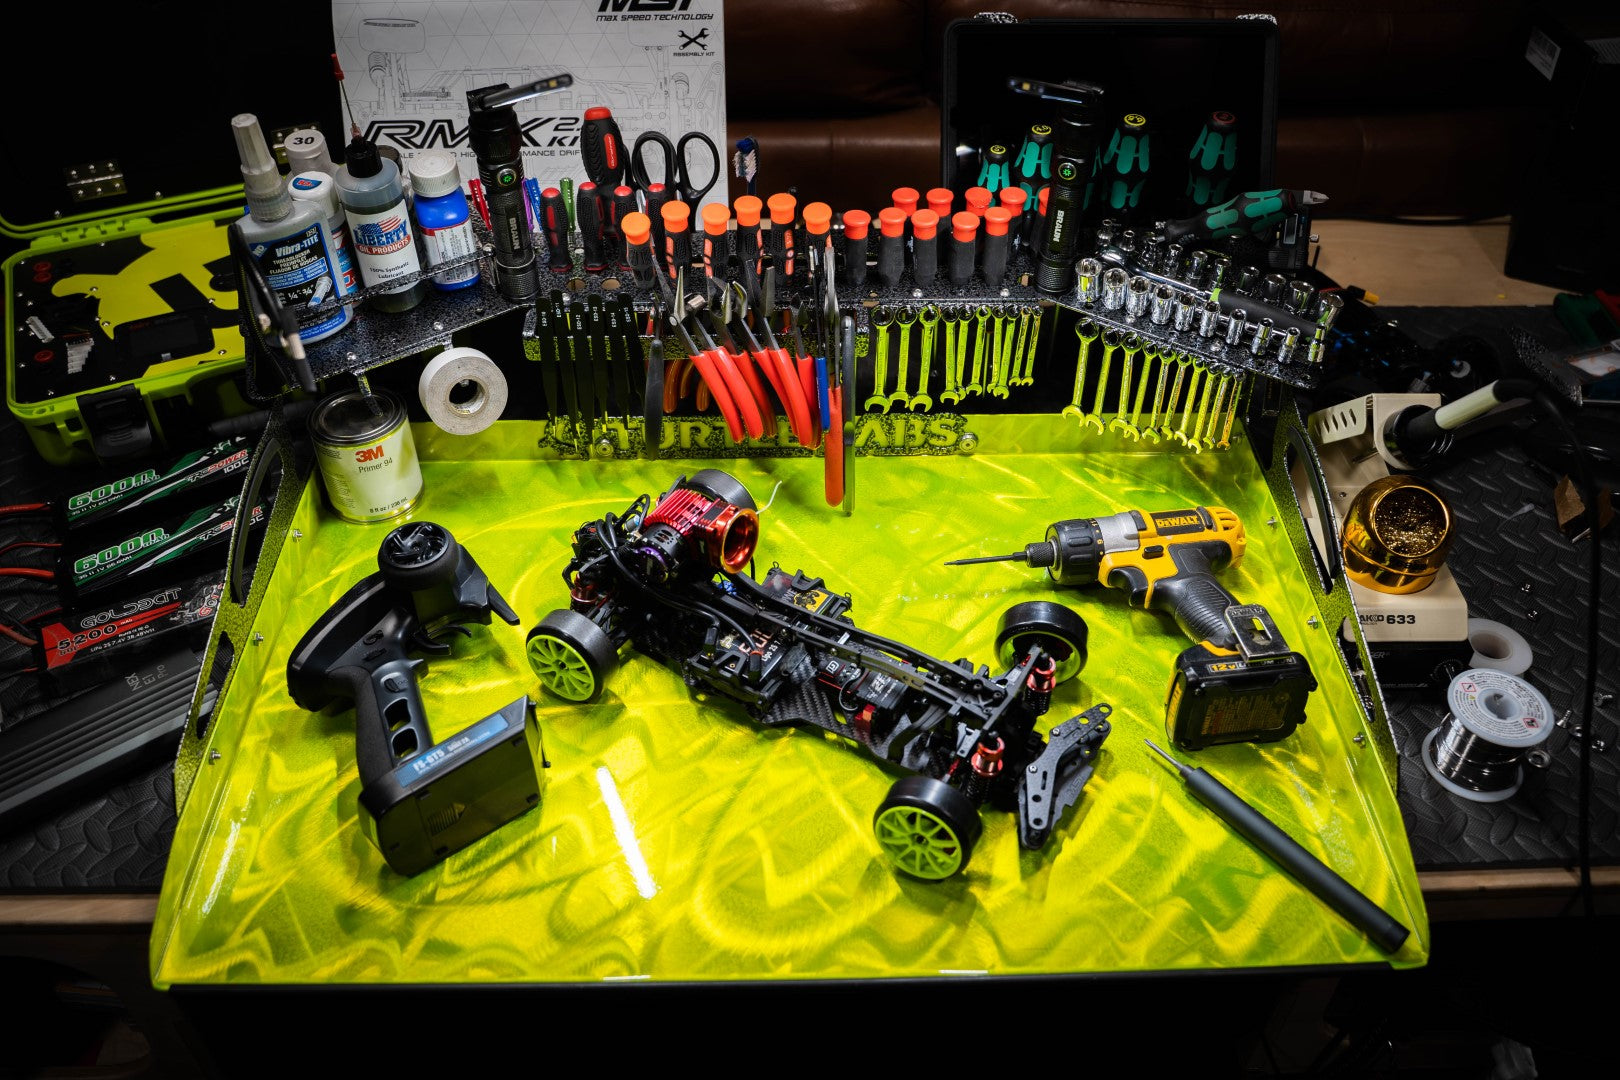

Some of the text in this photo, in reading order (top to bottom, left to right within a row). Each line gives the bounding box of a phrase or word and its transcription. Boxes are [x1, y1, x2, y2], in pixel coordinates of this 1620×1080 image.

[654, 13, 714, 21] TECHNOLOGY
[293, 136, 315, 145] 30
[546, 135, 580, 147] KI
[353, 219, 408, 246] LIBERTY
[509, 217, 521, 250] BRAUN
[1052, 209, 1065, 243] BRAUN
[275, 233, 319, 258] Vibra-TITE
[359, 237, 409, 254] OIL PRODUCTS
[378, 271, 404, 279] Lubricant
[385, 261, 409, 273] Synthetic
[355, 445, 384, 463] 3M
[224, 456, 249, 474] 100C
[358, 457, 393, 474] Primer 94
[1359, 614, 1384, 622] AKKO
[1386, 614, 1416, 624] 633
[57, 624, 118, 650] 5200
[124, 672, 143, 692] NEX
